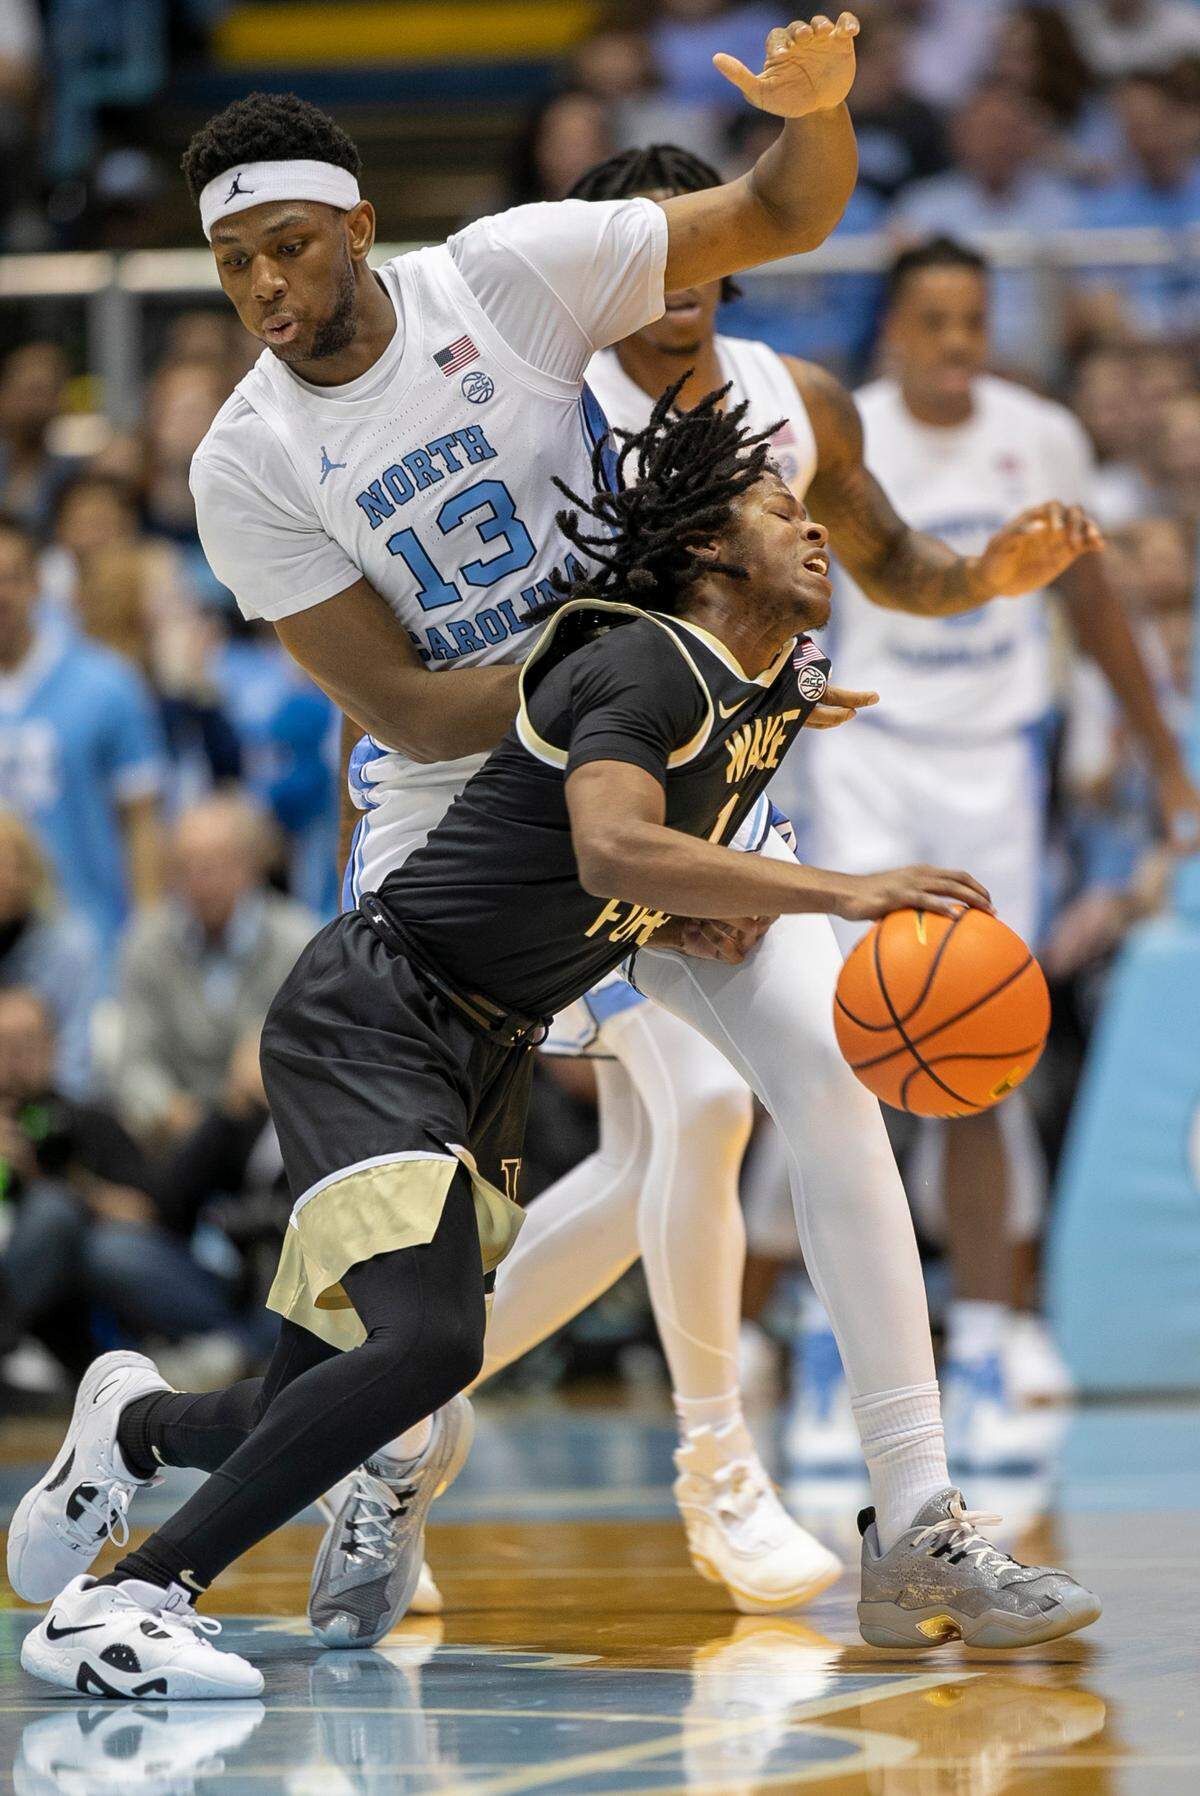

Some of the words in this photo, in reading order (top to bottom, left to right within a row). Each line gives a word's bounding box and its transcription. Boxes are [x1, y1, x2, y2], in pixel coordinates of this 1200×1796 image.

[467, 375, 490, 395] ACC
[356, 424, 498, 530] NORTH
[386, 479, 538, 612] 13
[802, 677, 824, 687] ACC
[724, 709, 800, 783] WAKE
